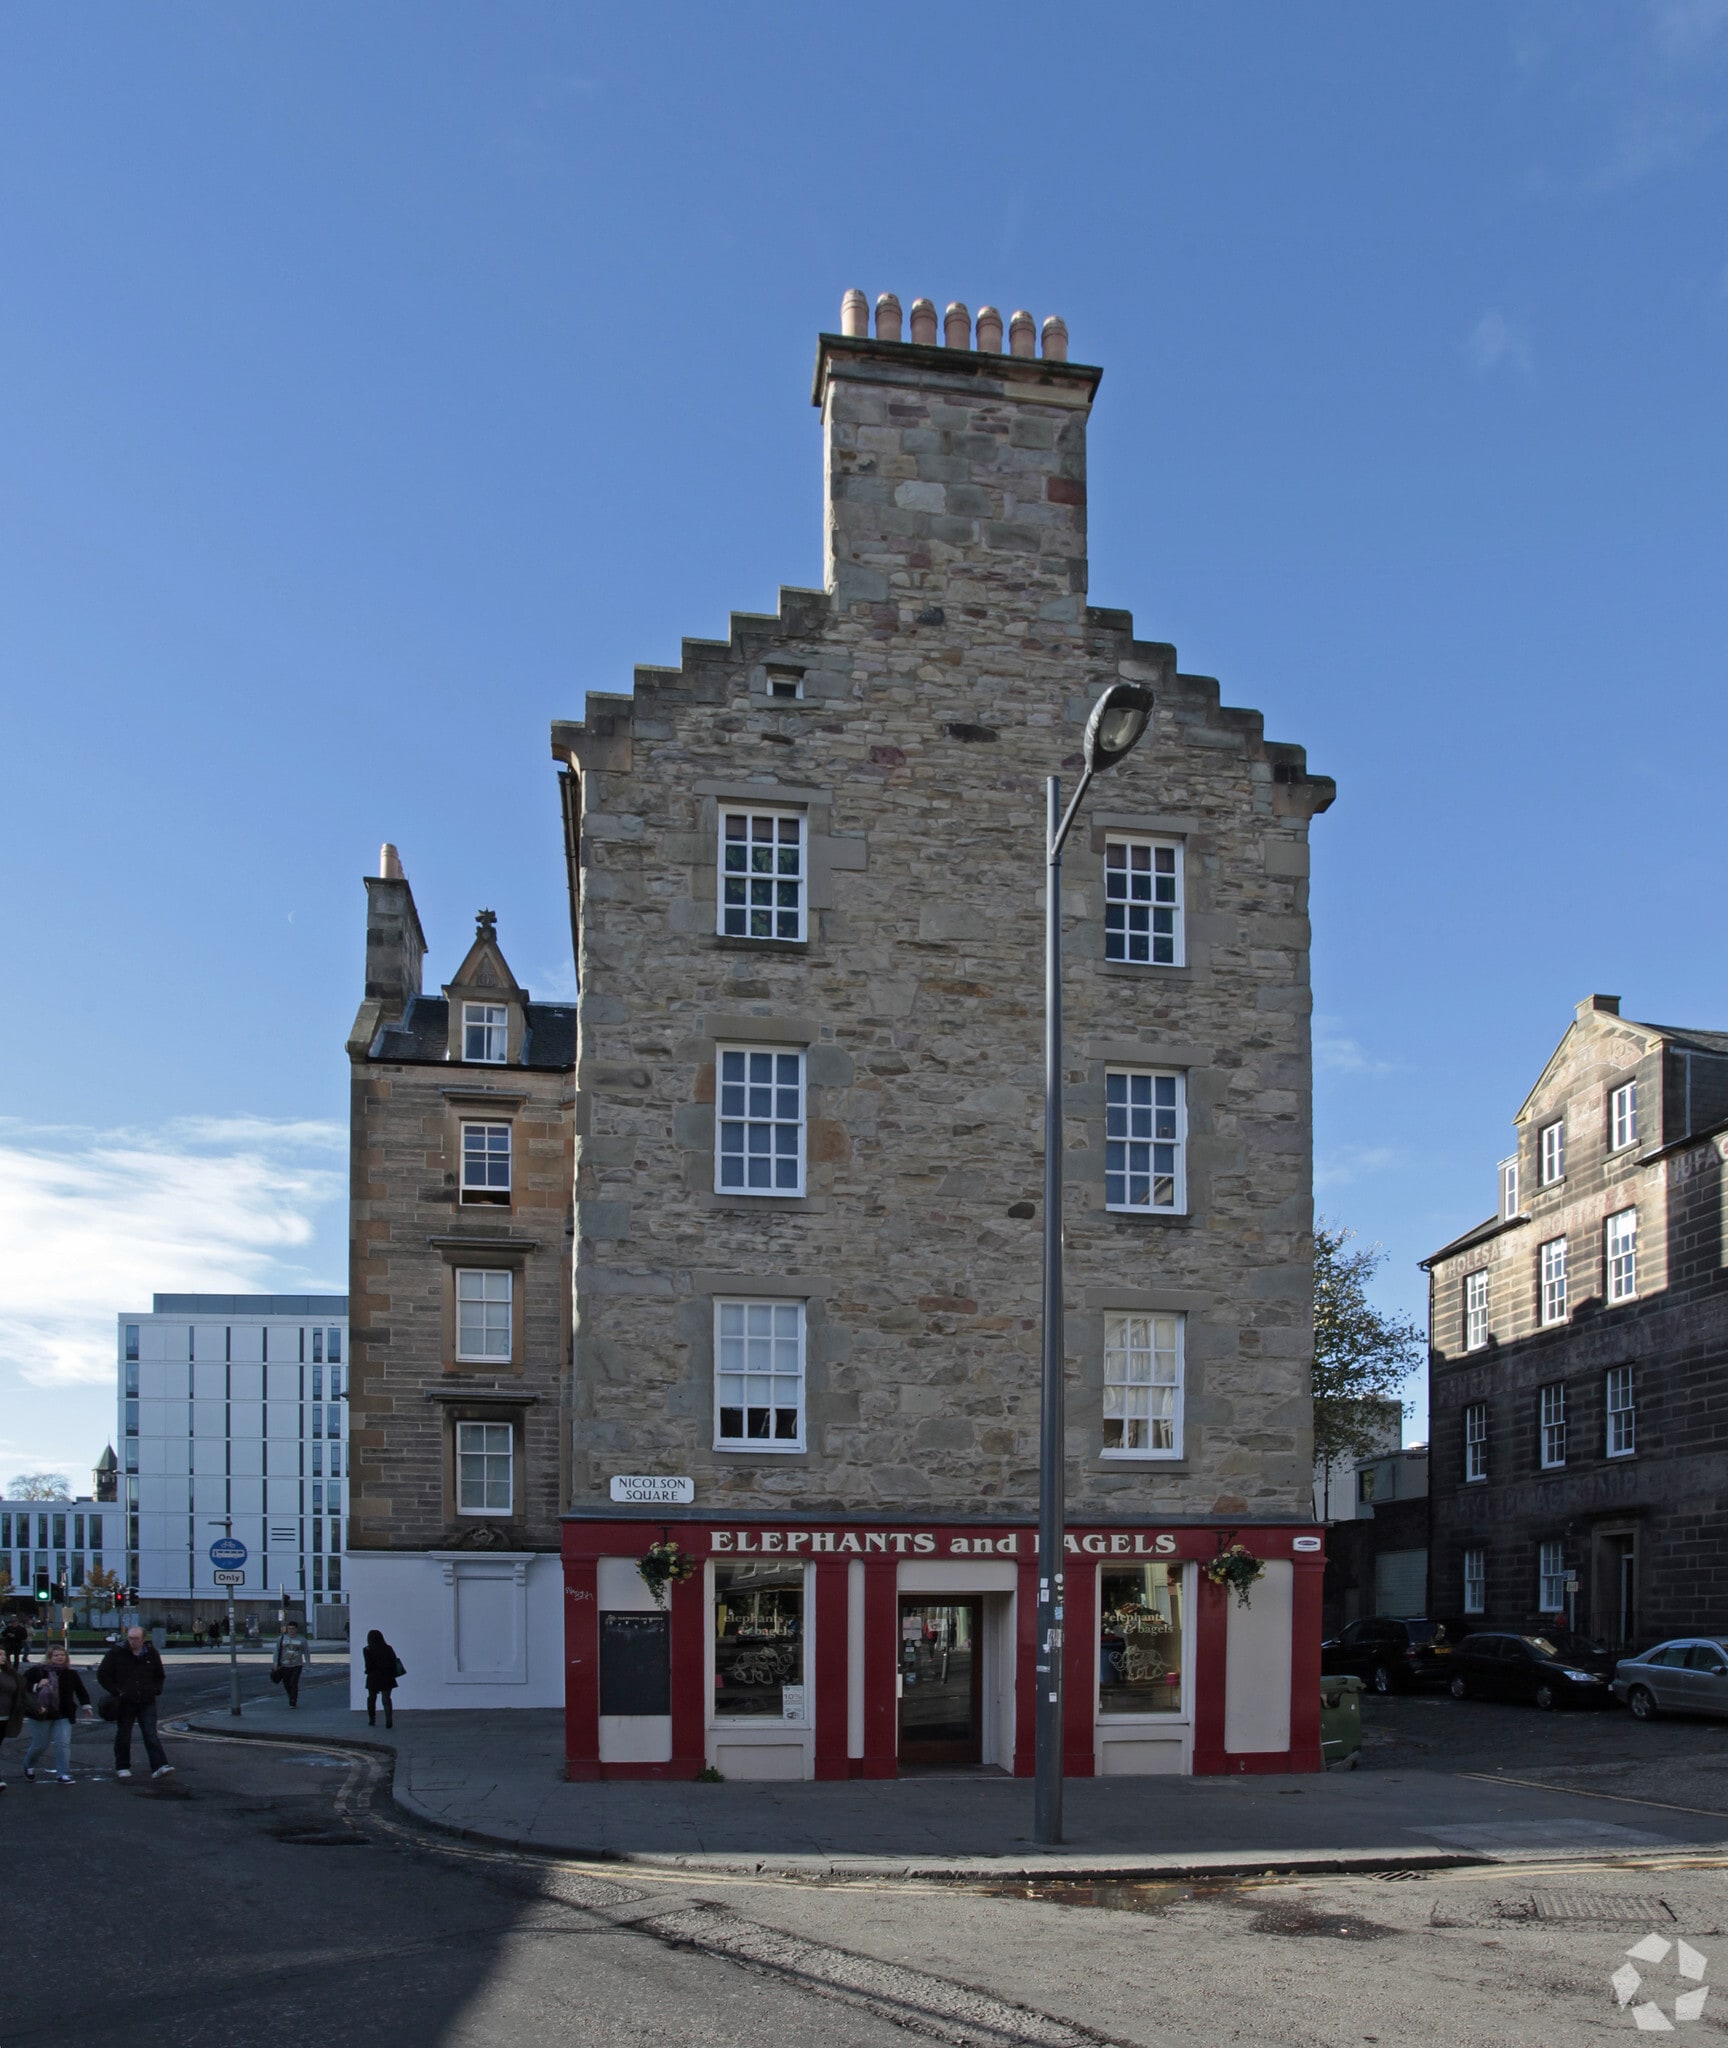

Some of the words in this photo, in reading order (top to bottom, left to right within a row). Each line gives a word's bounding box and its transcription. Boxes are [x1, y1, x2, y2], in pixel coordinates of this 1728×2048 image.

[1440, 1236, 1510, 1278] HOLESA
[619, 1478, 686, 1489] NICOLSON
[625, 1490, 678, 1501] SQUARE
[710, 1531, 936, 1553] ELEPHANTS
[950, 1533, 1018, 1553] and
[1033, 1534, 1177, 1553] AGELS
[218, 1573, 240, 1582] Only
[724, 1613, 784, 1624] elephants
[1109, 1613, 1165, 1625] elephants
[755, 1626, 793, 1638] bagels
[1138, 1623, 1174, 1636] bagels
